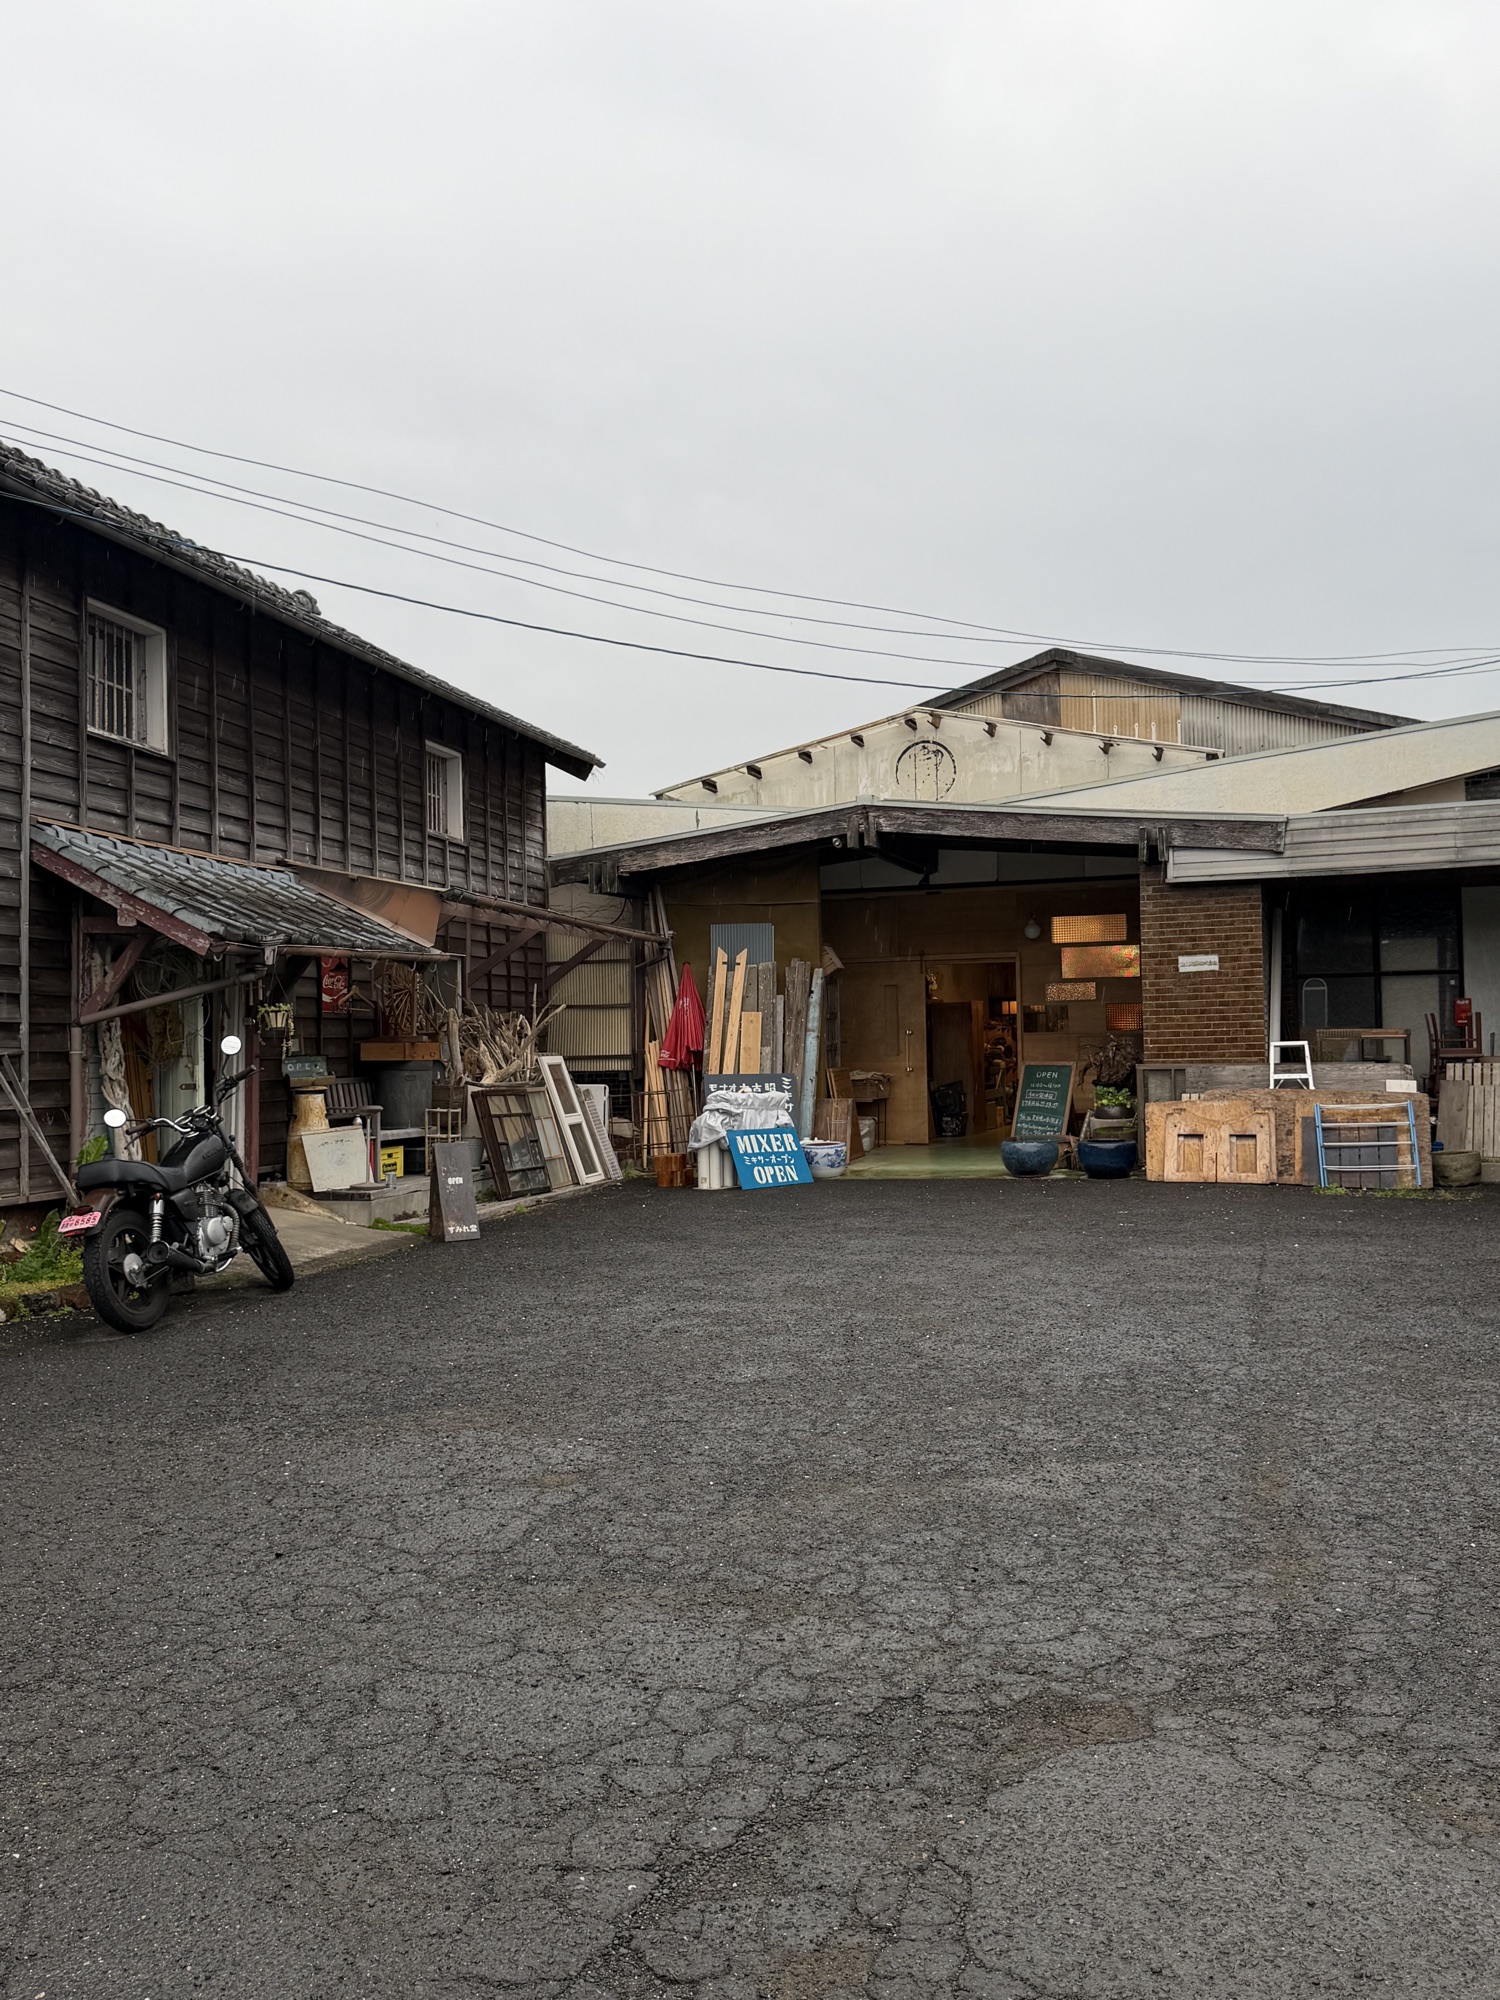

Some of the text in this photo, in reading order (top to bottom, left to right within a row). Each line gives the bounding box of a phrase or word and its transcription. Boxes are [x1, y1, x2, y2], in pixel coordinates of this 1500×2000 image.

[1036, 1071, 1058, 1079] OPEN
[737, 1134, 797, 1153] MIXER
[744, 1154, 794, 1164] ミキサーオープン
[753, 1165, 798, 1184] OPEN
[447, 1176, 464, 1185] OPEN
